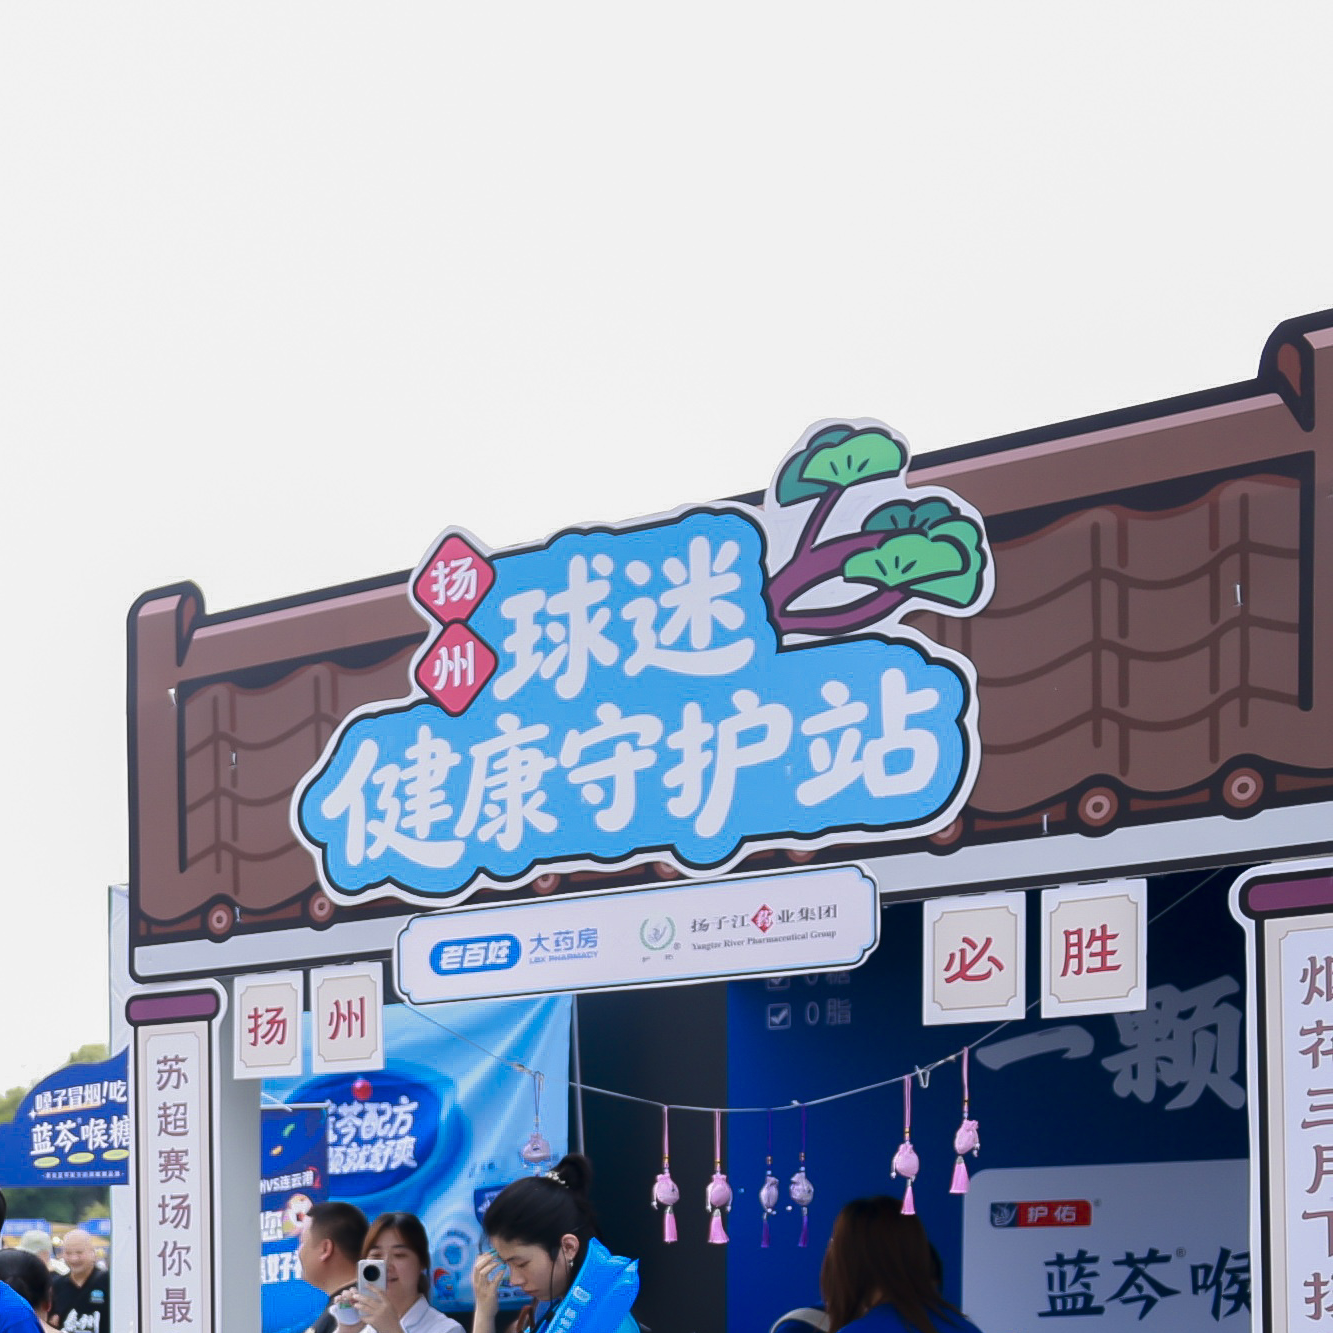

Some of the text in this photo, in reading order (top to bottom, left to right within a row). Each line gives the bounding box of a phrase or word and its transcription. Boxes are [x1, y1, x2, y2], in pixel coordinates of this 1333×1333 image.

[431, 555, 479, 691] 扬州
[493, 536, 754, 701] 球迷
[321, 668, 939, 867] 健康守护站
[440, 927, 598, 970] 老百姓 大药房
[723, 938, 745, 948] River
[747, 932, 808, 946] Pharmaceutical
[810, 929, 837, 940] Group
[975, 974, 1246, 1111] 一颗
[1037, 1246, 1252, 1322] 蓝芩喉
